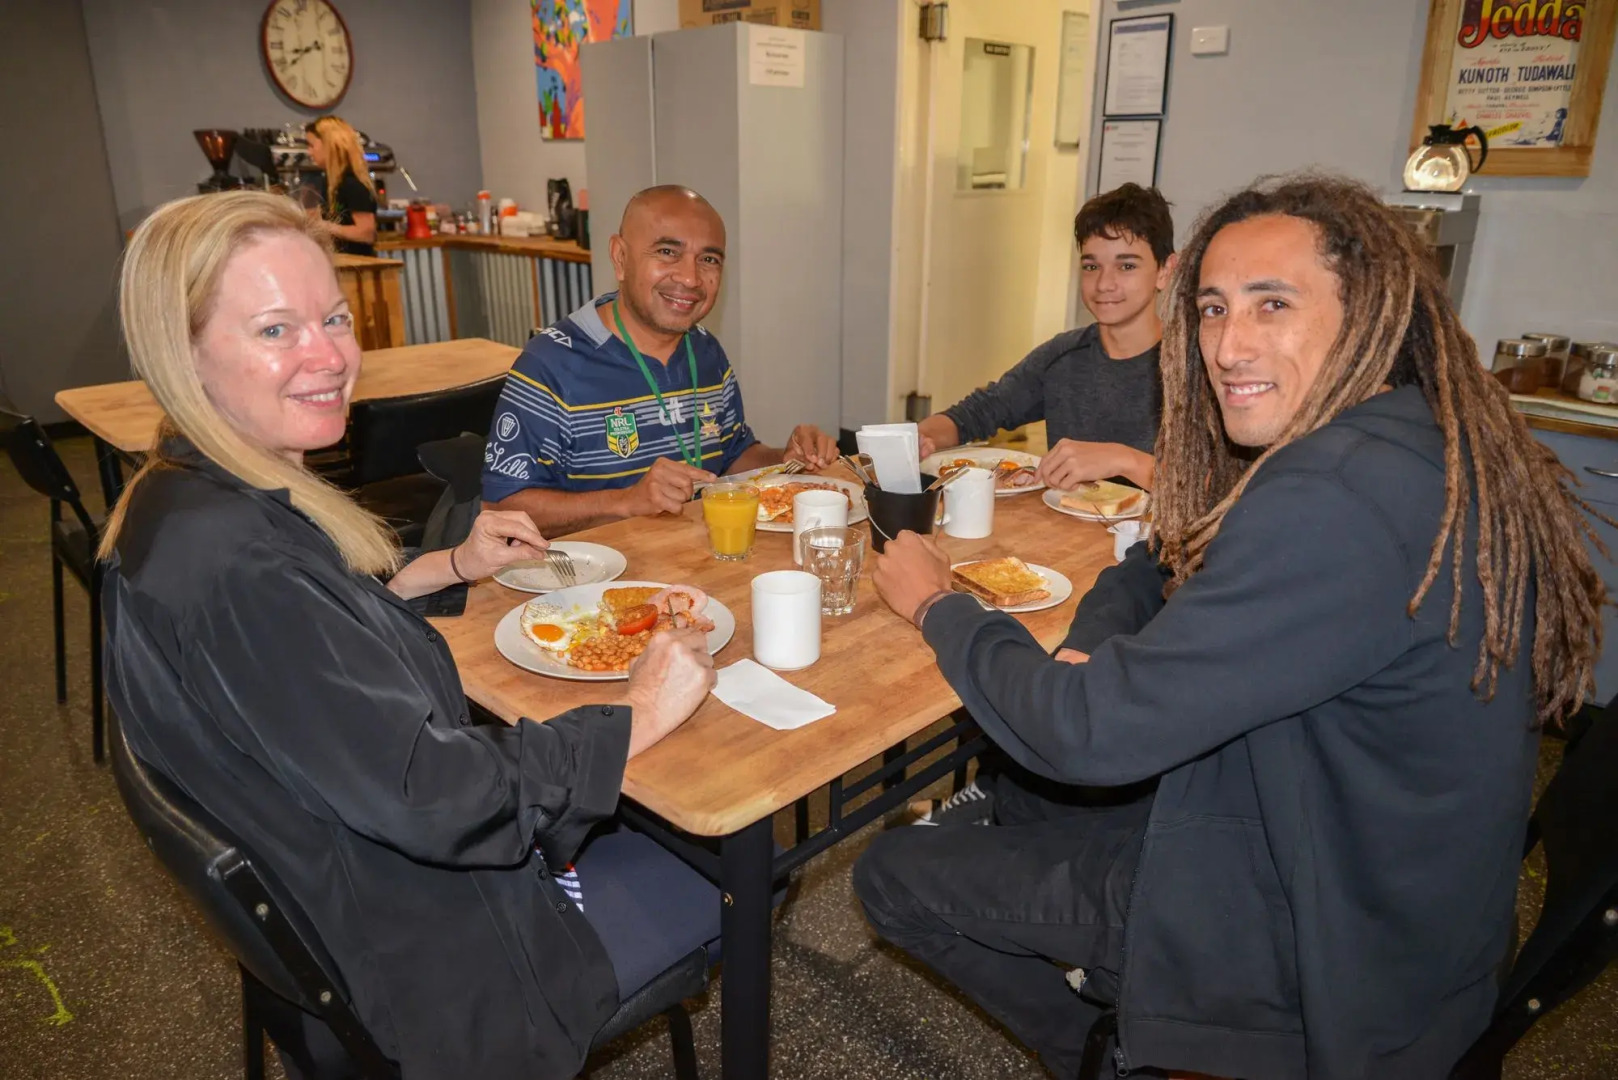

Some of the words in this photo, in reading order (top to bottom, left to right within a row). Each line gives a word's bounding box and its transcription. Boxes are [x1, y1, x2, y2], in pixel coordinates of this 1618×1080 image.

[1458, 0, 1586, 49] Jedda
[1458, 67, 1510, 84] KUNOTH
[1517, 64, 1576, 82] TUDAWALI
[610, 416, 632, 428] NRL
